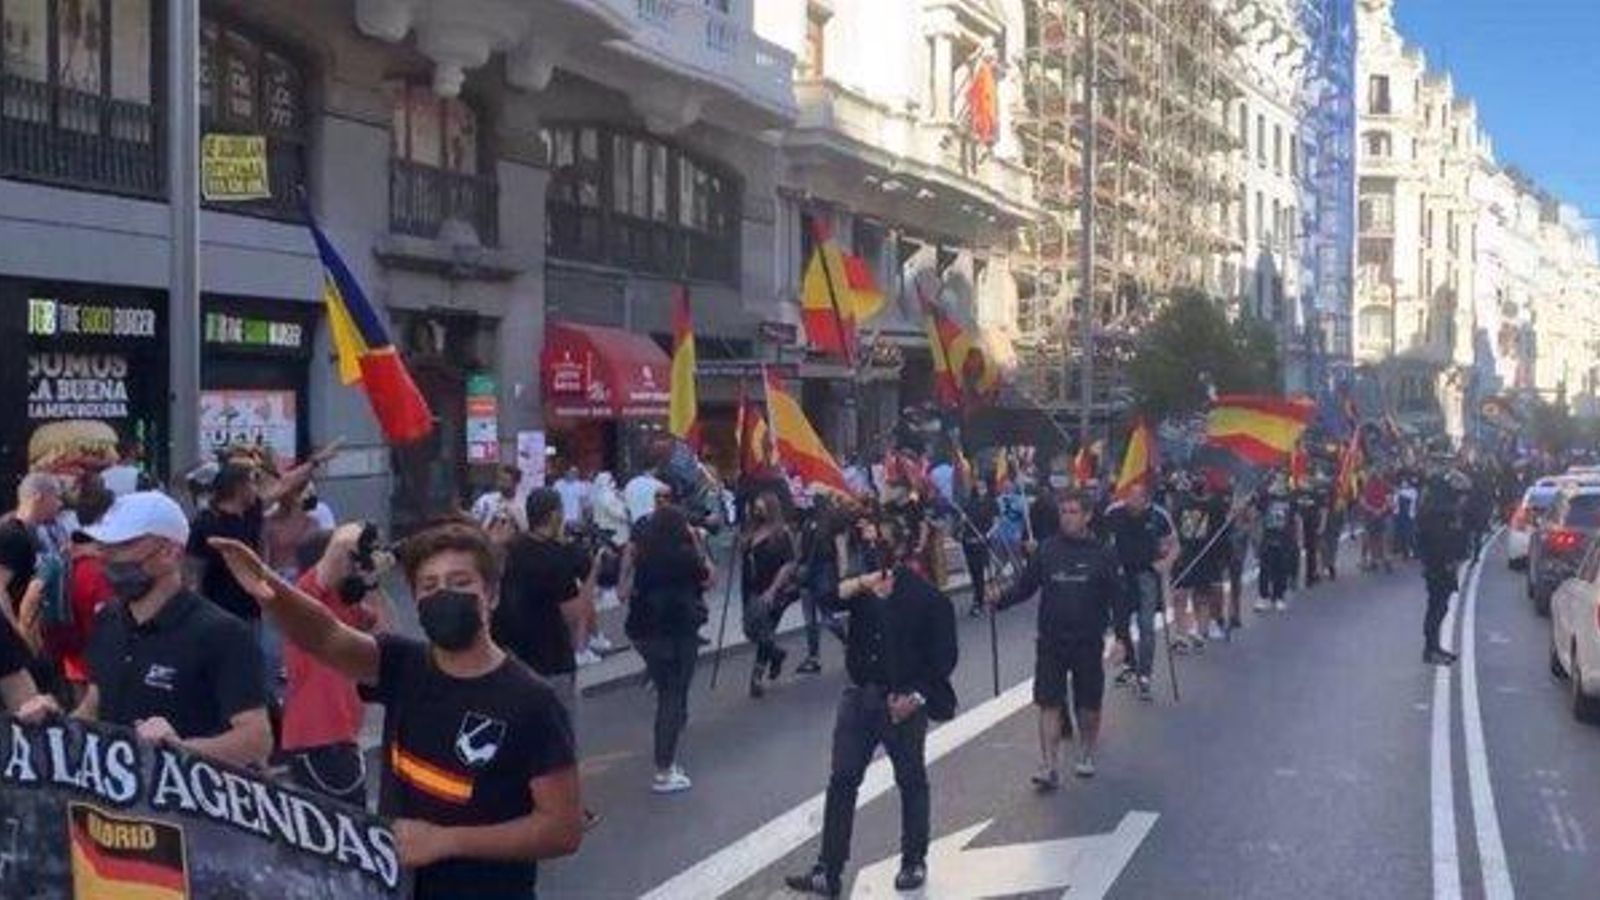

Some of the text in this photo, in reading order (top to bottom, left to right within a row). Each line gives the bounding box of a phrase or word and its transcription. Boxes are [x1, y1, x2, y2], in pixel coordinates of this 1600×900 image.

[4, 723, 399, 888] A LAS AGENDAS
